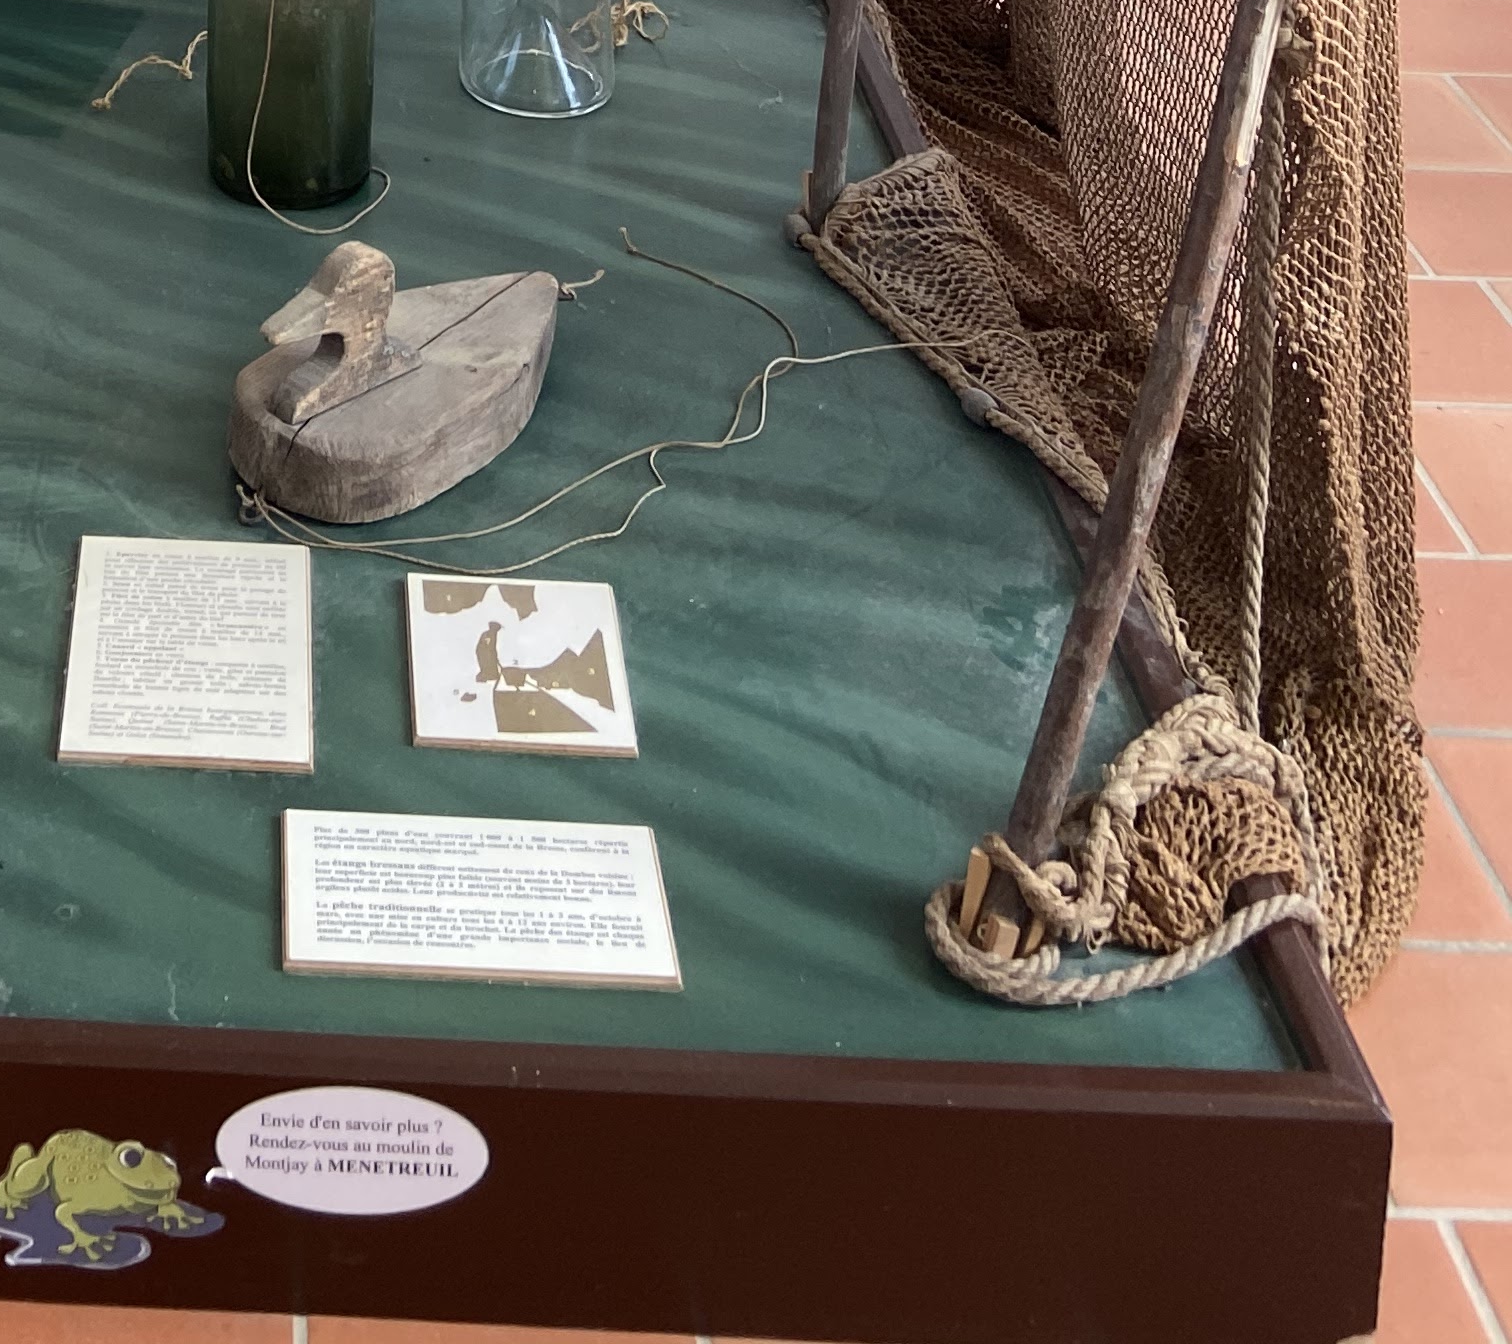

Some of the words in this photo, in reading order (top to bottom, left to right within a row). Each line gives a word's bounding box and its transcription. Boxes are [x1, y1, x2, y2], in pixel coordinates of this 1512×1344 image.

[261, 1113, 305, 1128] Envie
[309, 1115, 340, 1130] d'en
[345, 1117, 392, 1131] savoir
[397, 1119, 429, 1136] plus
[434, 1120, 443, 1134] ?
[249, 1133, 349, 1151] Rendez-vous
[353, 1139, 371, 1152] au
[376, 1140, 430, 1155] moulin
[435, 1141, 454, 1155] de
[244, 1154, 308, 1174] Montjay
[314, 1157, 322, 1172] à
[328, 1159, 459, 1178] MENETREUIL
